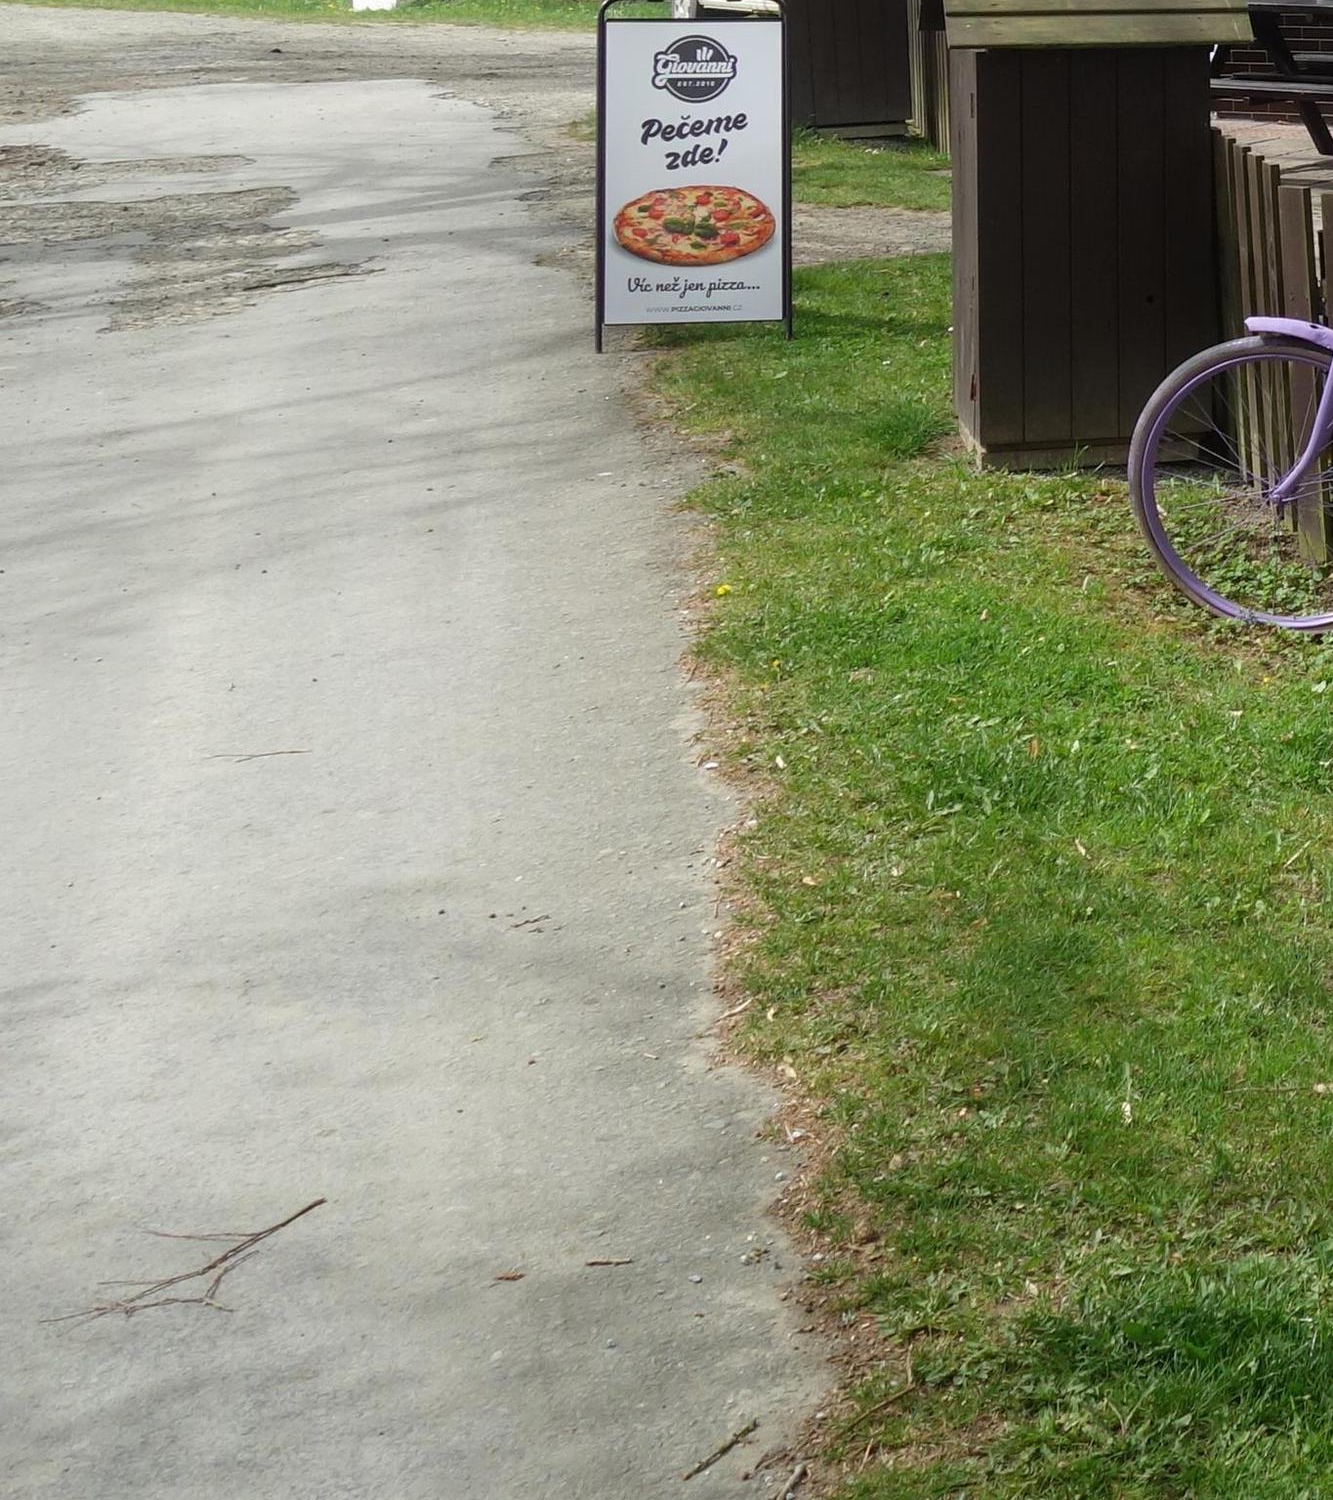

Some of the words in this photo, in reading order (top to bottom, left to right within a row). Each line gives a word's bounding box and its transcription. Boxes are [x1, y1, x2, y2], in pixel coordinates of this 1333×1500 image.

[654, 53, 735, 87] Giovanni
[641, 113, 749, 146] Pečeme
[665, 138, 728, 171] zde!
[627, 277, 653, 293] Víc
[656, 276, 681, 292] než
[679, 279, 706, 299] jen
[708, 278, 761, 299] pizza...
